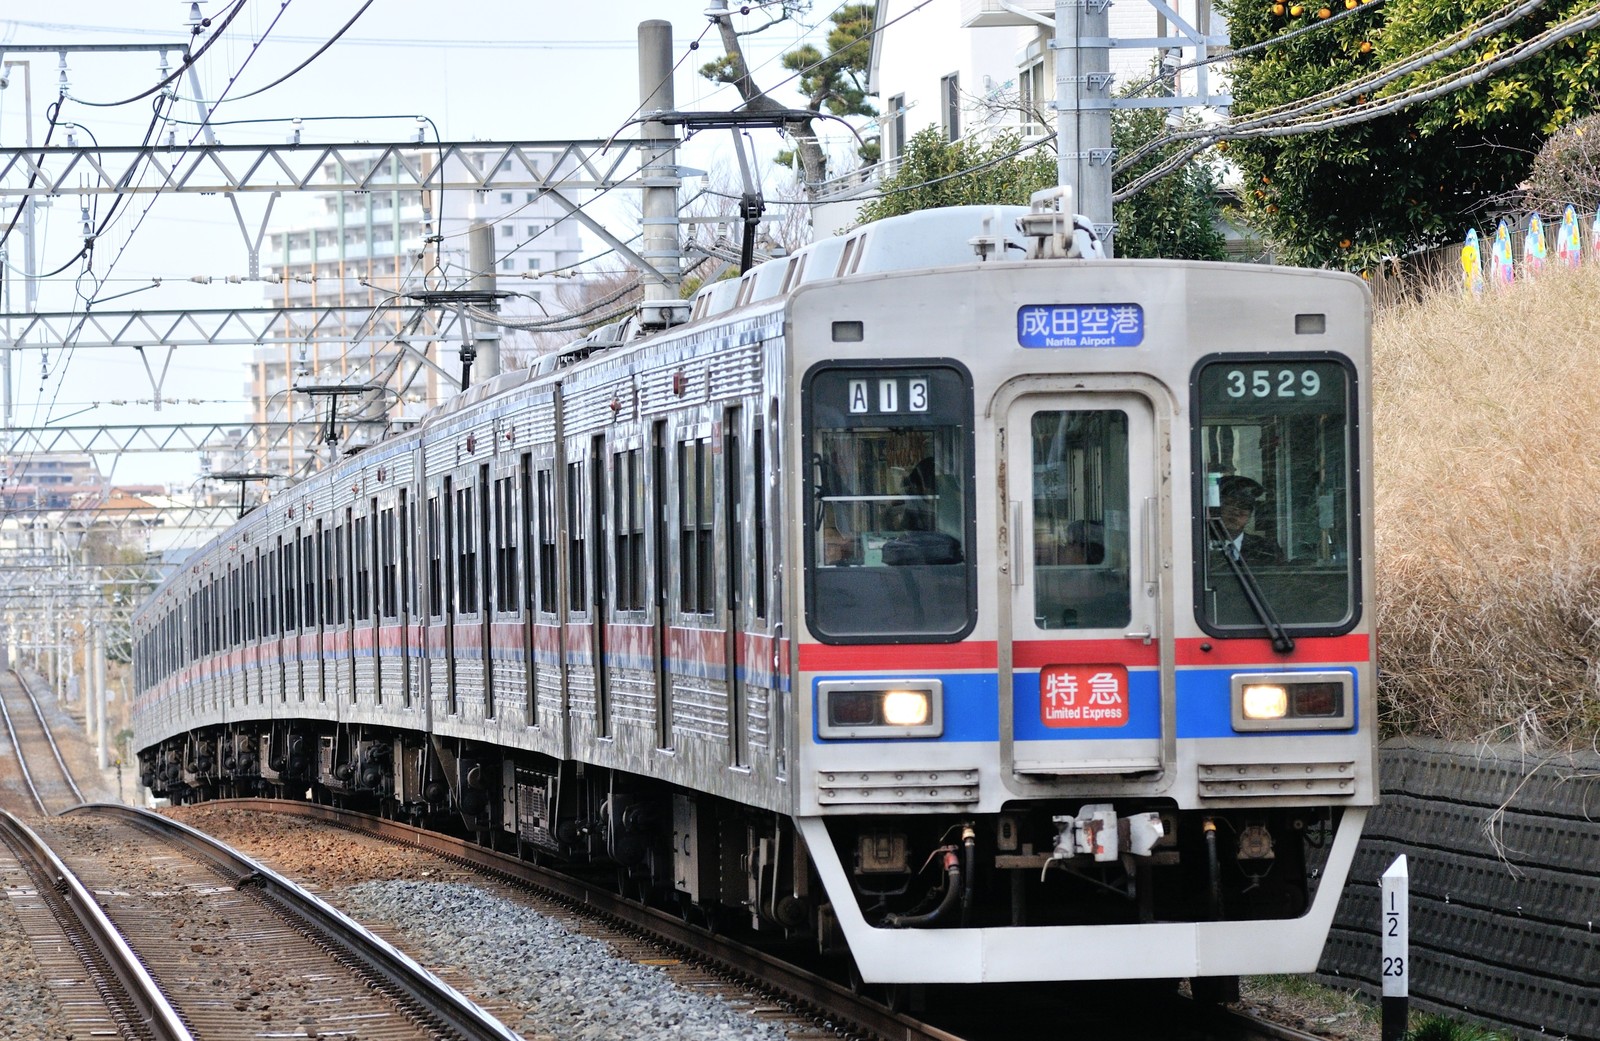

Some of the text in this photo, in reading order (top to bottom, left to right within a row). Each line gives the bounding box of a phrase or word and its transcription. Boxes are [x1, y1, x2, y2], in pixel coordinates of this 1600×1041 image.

[1021, 307, 1139, 337] 成田空港
[1046, 336, 1116, 347] Narita Airport
[1227, 369, 1320, 398] 3529
[1046, 673, 1122, 706] 特急
[1046, 706, 1122, 721] Limited Express
[1383, 957, 1404, 977] 23
